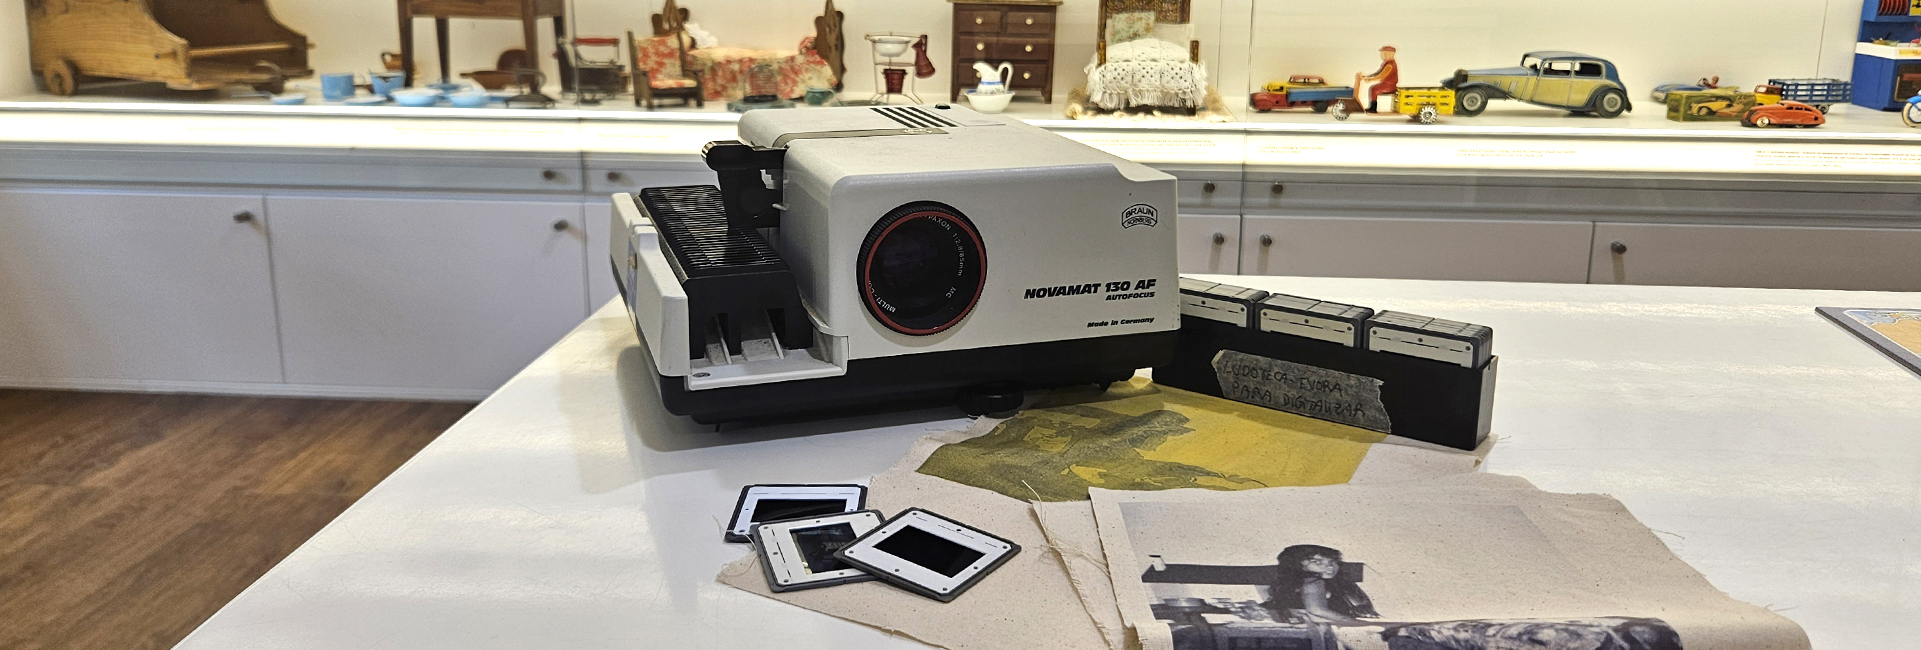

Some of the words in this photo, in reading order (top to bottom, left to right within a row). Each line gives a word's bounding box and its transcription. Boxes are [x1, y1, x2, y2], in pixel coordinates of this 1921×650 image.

[1125, 207, 1154, 218] BRAUN
[1024, 283, 1101, 299] NOVAMAT
[1105, 281, 1131, 293] 130
[1134, 279, 1157, 291] AF
[1105, 292, 1155, 300] AUTOFOCUS
[1120, 317, 1155, 325] Germany
[1231, 381, 1272, 402] PARA
[1299, 377, 1343, 397] EVORA
